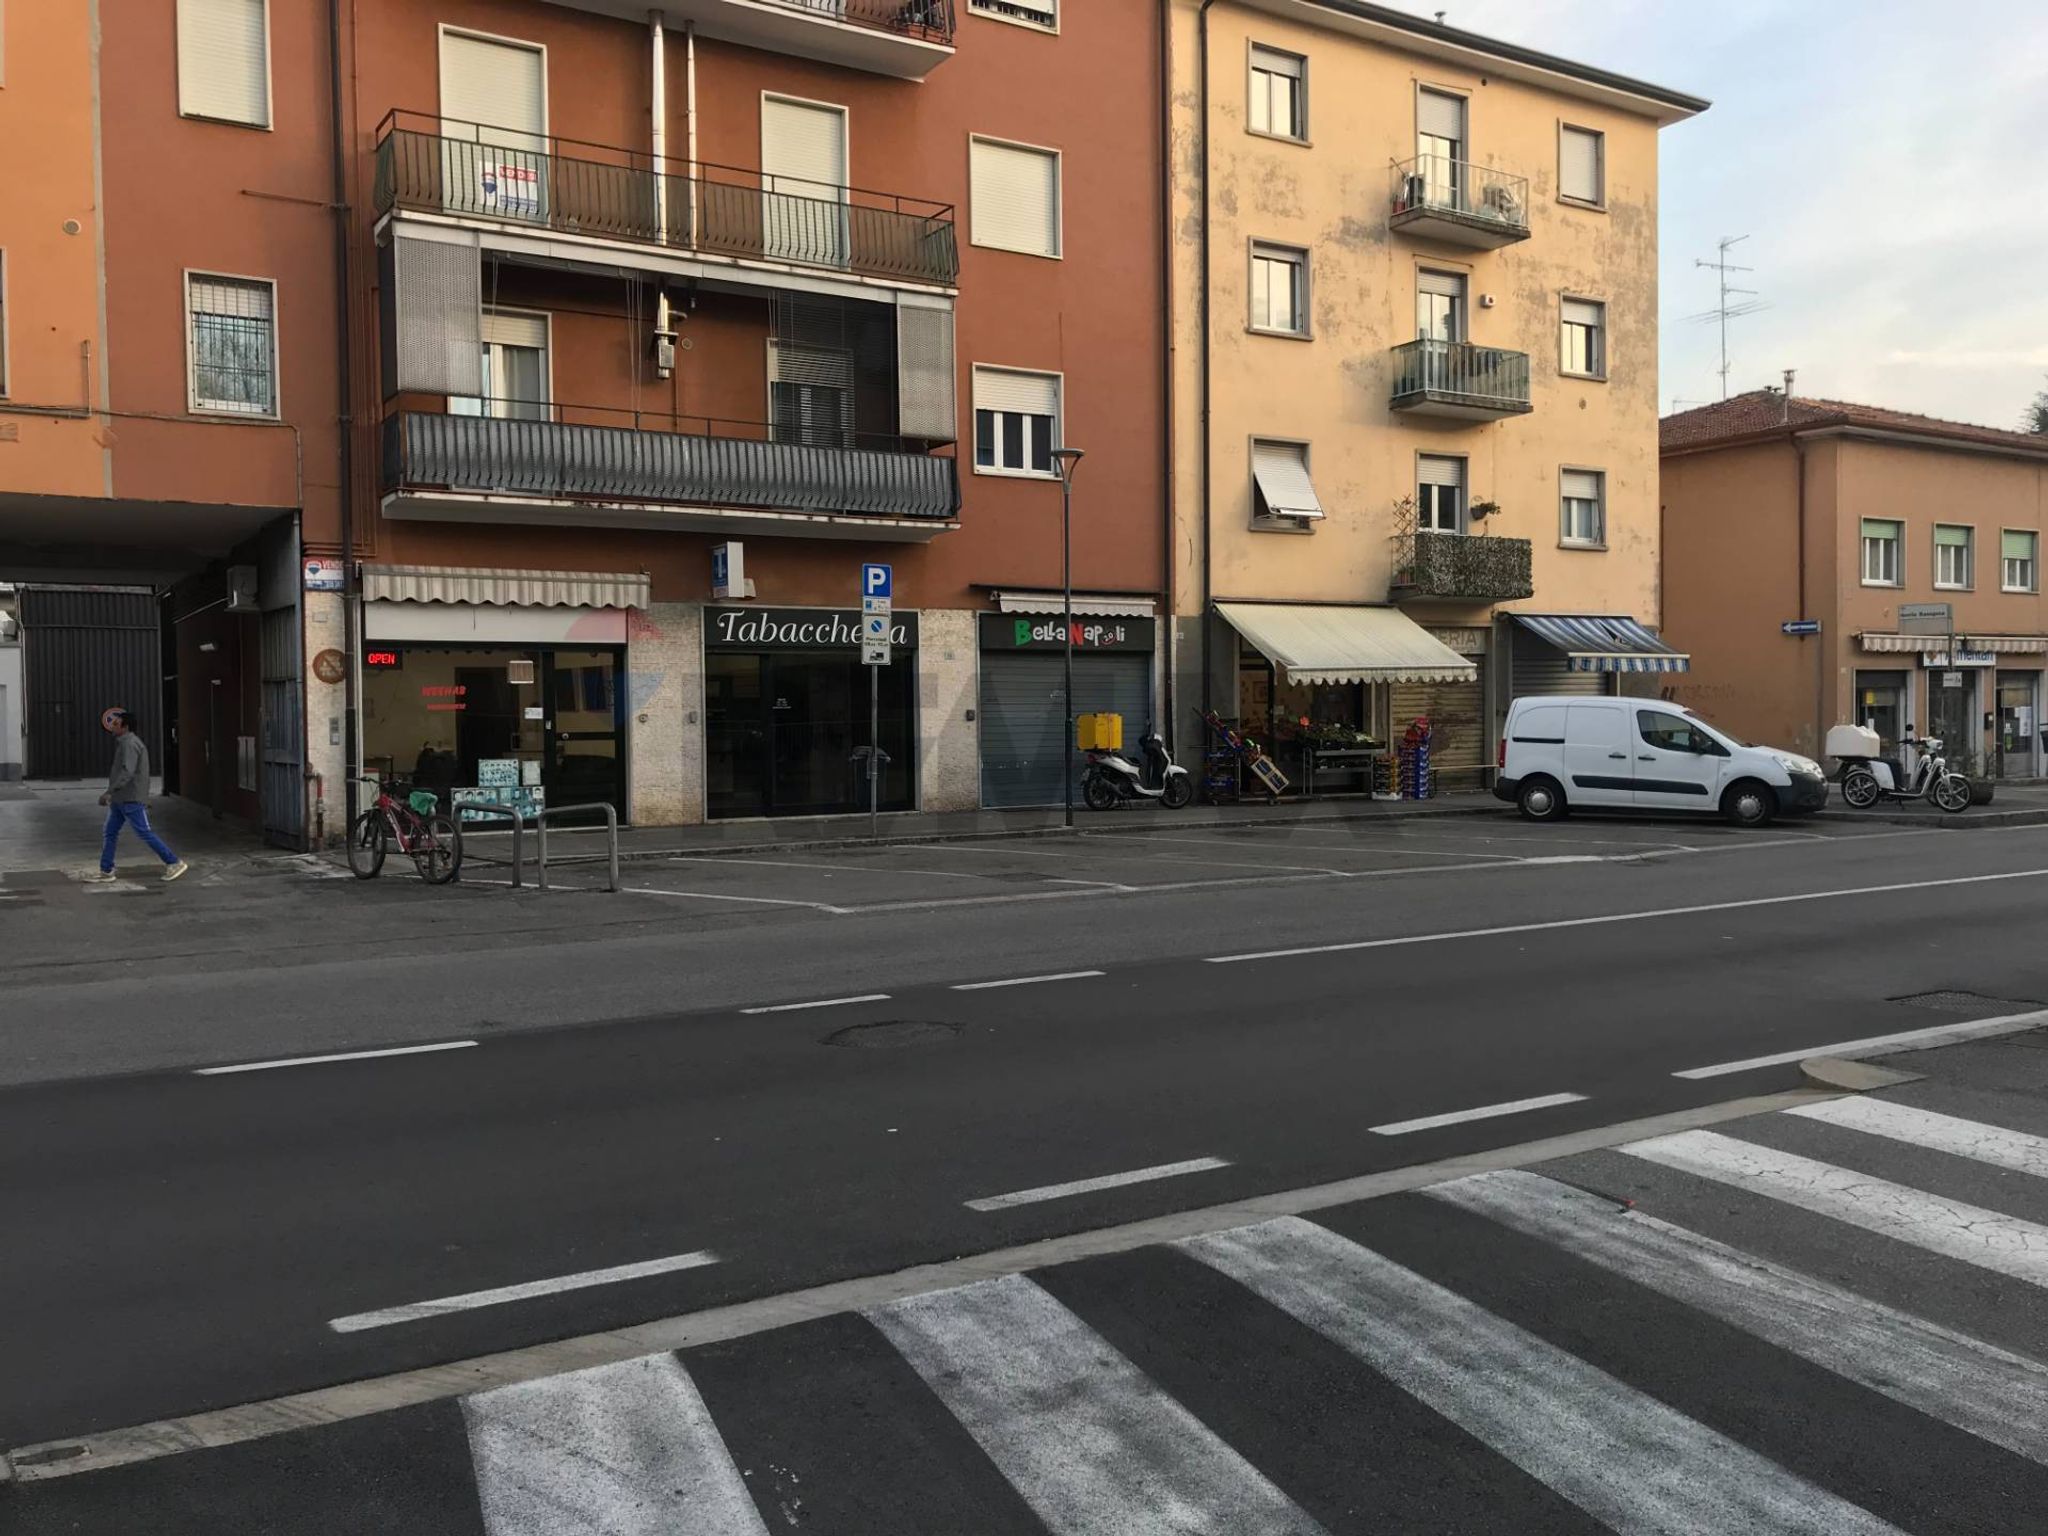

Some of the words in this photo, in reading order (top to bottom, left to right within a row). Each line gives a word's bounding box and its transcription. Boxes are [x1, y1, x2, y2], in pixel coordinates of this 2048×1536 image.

[868, 567, 886, 594] P
[717, 610, 908, 645] Tabacchea
[368, 653, 395, 665] OPEN
